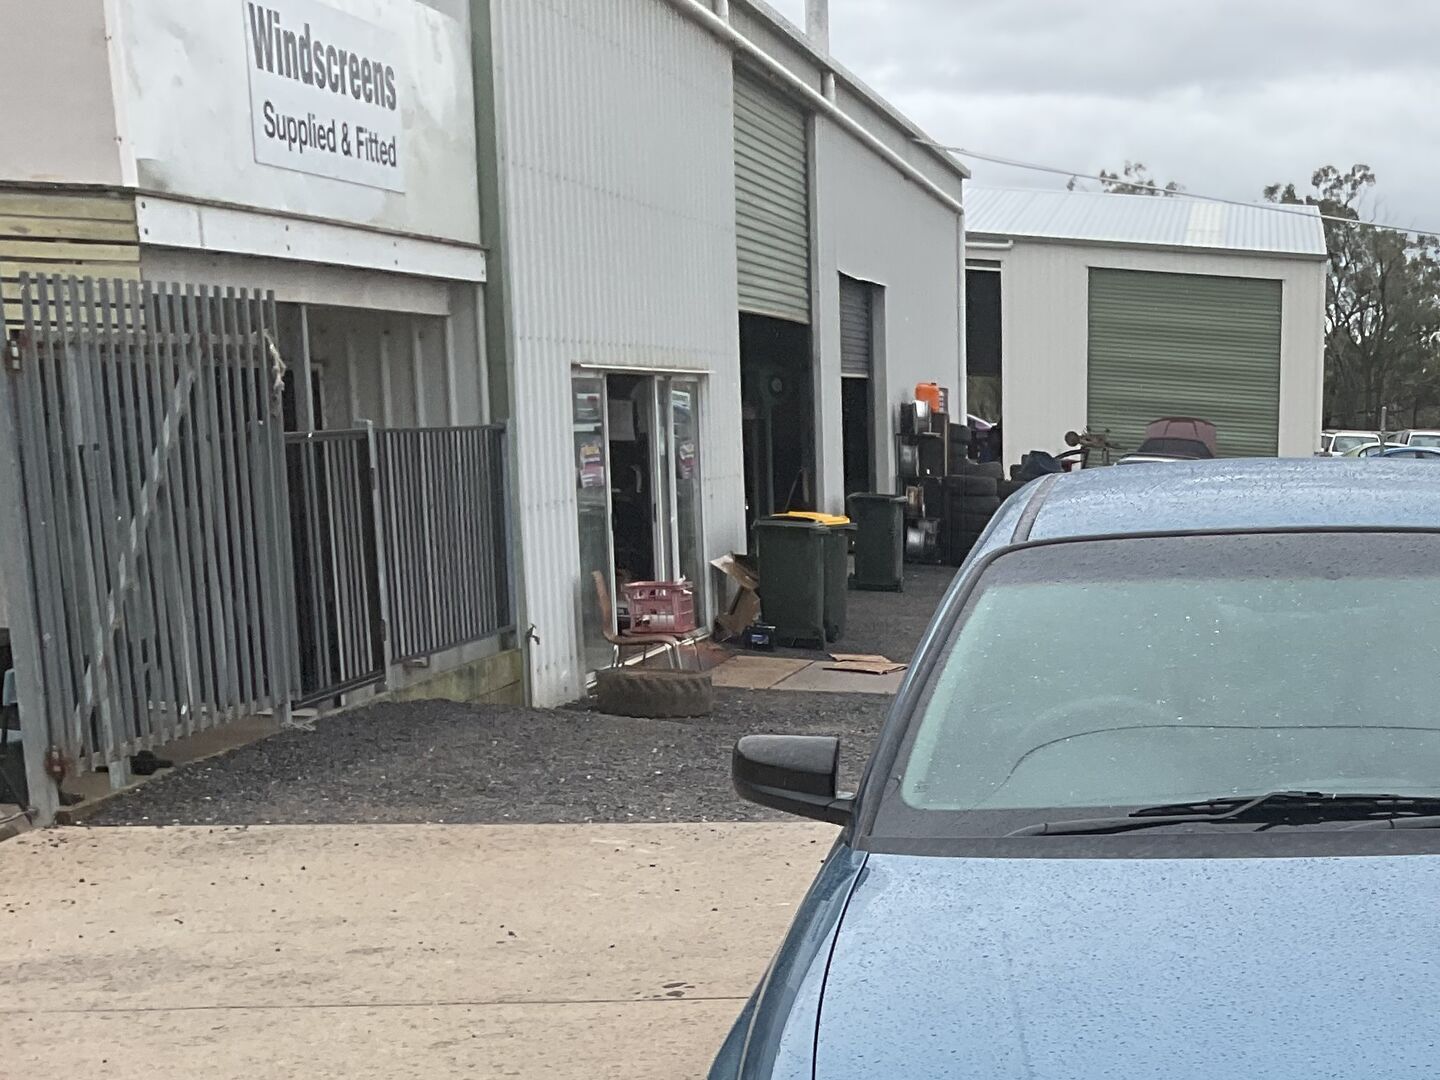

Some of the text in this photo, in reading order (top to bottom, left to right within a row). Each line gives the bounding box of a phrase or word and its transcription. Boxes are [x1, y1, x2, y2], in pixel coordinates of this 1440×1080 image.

[249, 3, 397, 111] Windscreens
[263, 99, 396, 168] Supplied & Fitted
